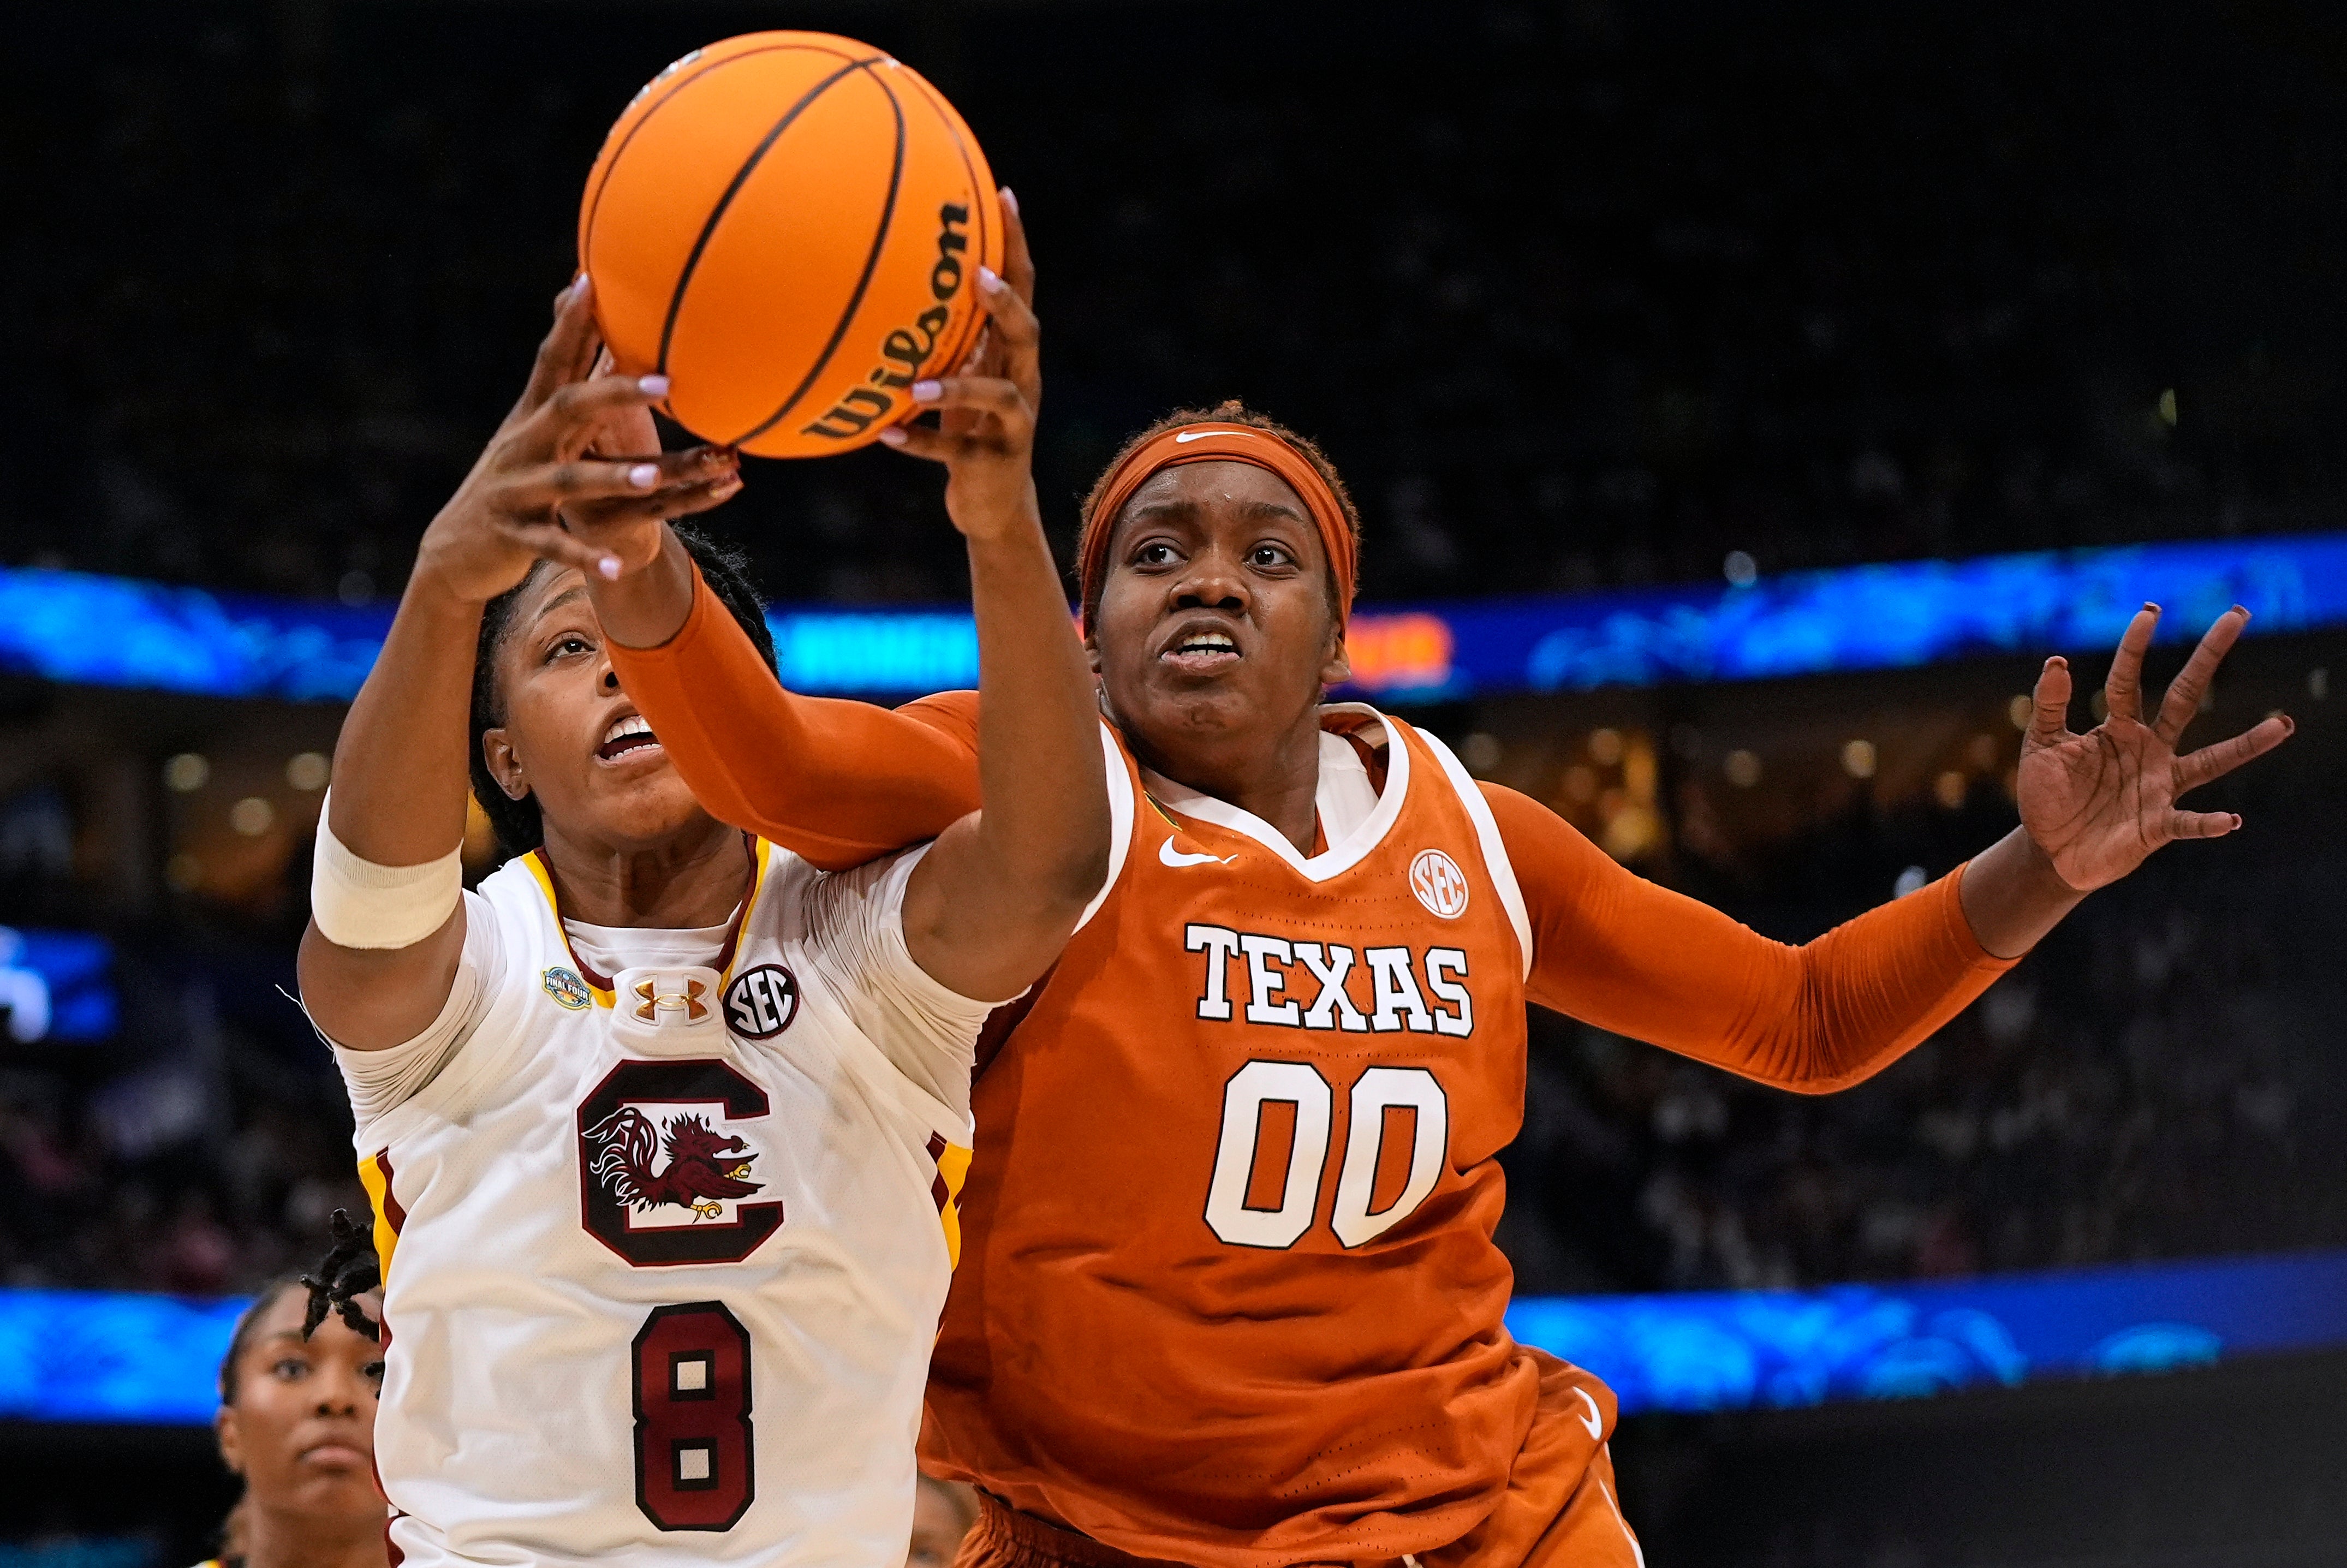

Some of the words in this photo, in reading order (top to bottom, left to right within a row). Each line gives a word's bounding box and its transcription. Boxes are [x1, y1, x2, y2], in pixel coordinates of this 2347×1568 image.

[800, 203, 969, 439] Wilson
[1414, 854, 1465, 915] SEC
[546, 976, 567, 991] FINAL
[568, 984, 588, 1001] FOUR
[730, 969, 793, 1033] SEC
[1184, 922, 1474, 1039] TEXAS
[1202, 1058, 1449, 1250] 00
[632, 1300, 755, 1533] 8
